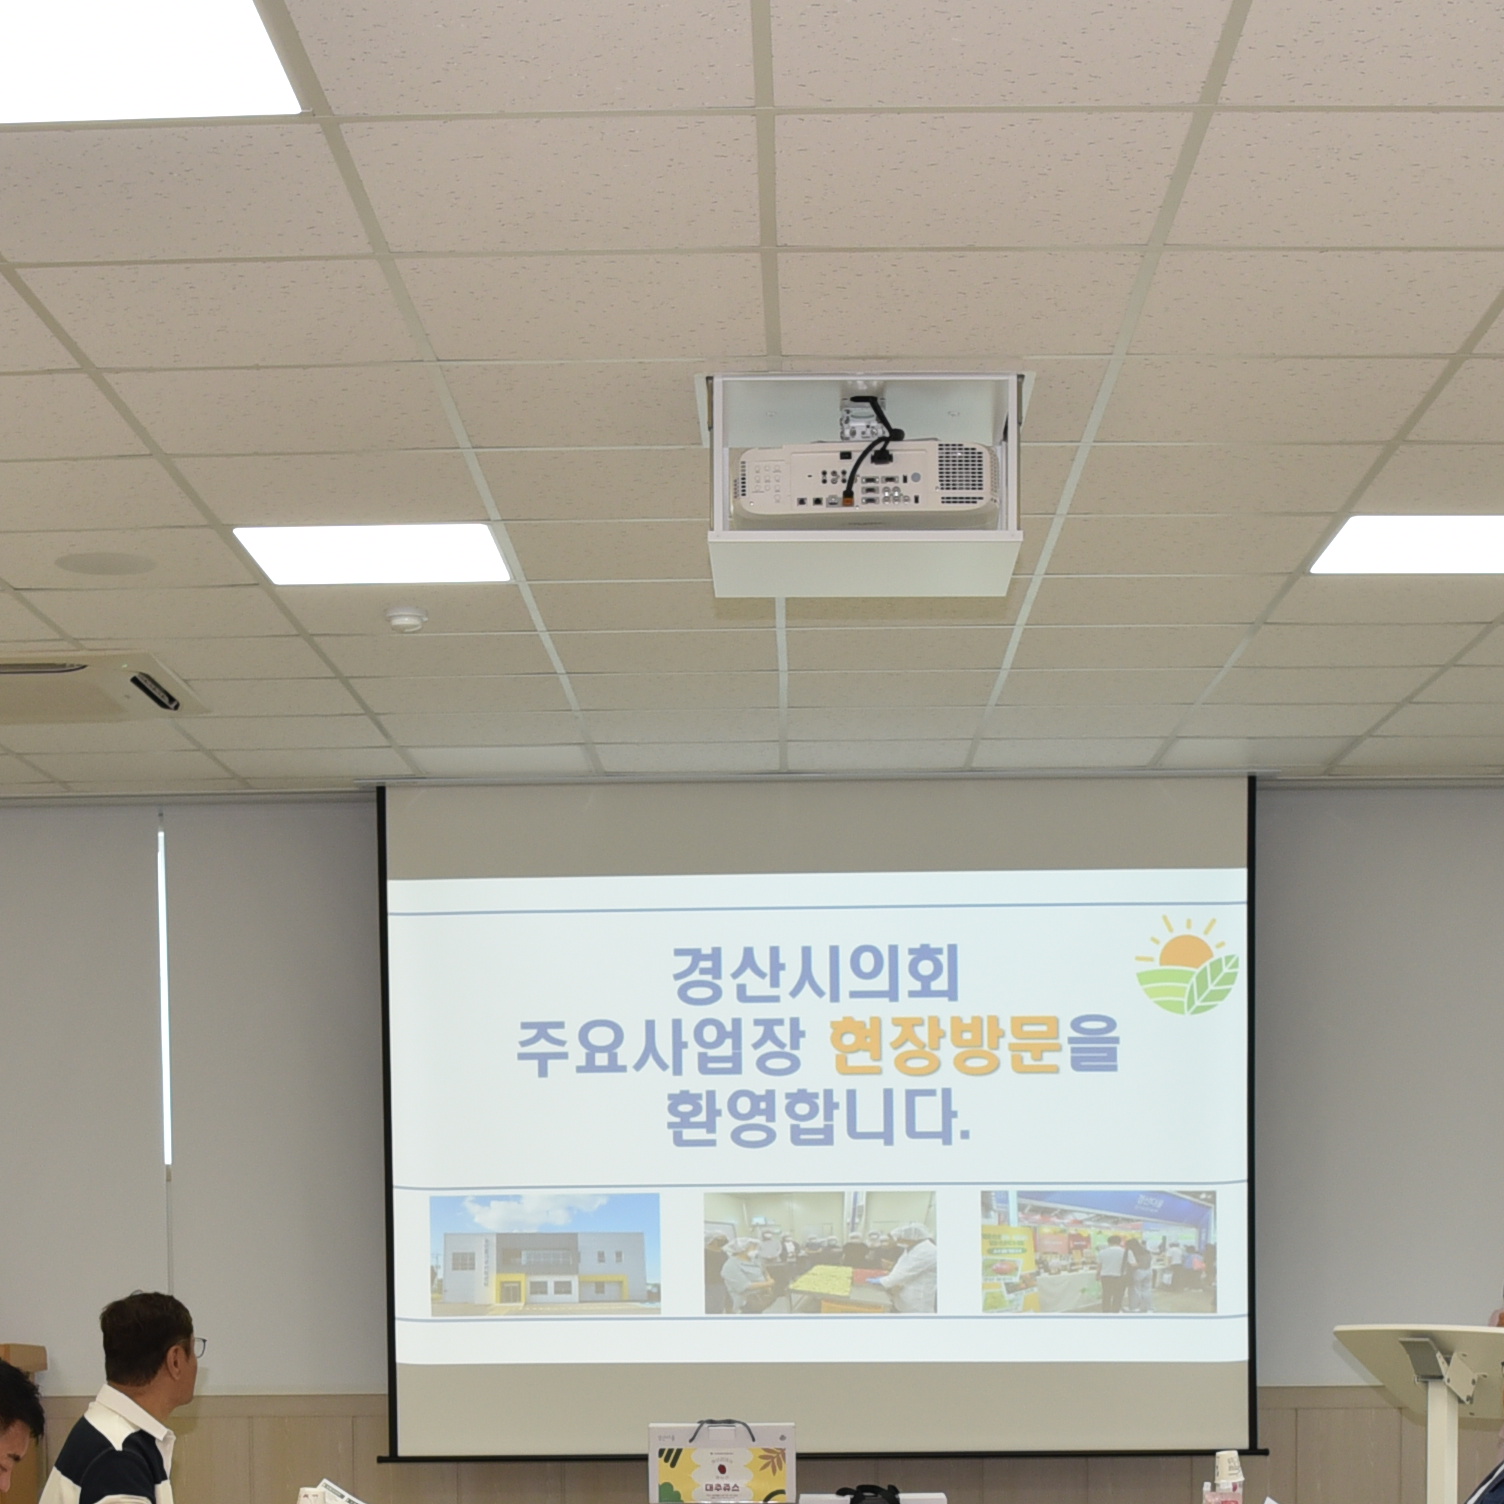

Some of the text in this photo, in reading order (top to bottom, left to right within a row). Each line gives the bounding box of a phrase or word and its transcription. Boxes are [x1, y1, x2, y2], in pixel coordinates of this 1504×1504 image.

[671, 944, 961, 1006] 경산시의회
[517, 1014, 1121, 1078] 주요사업장 현장방문을
[666, 1088, 970, 1149] 환영합니다.
[705, 1483, 740, 1492] 대추쥬스
